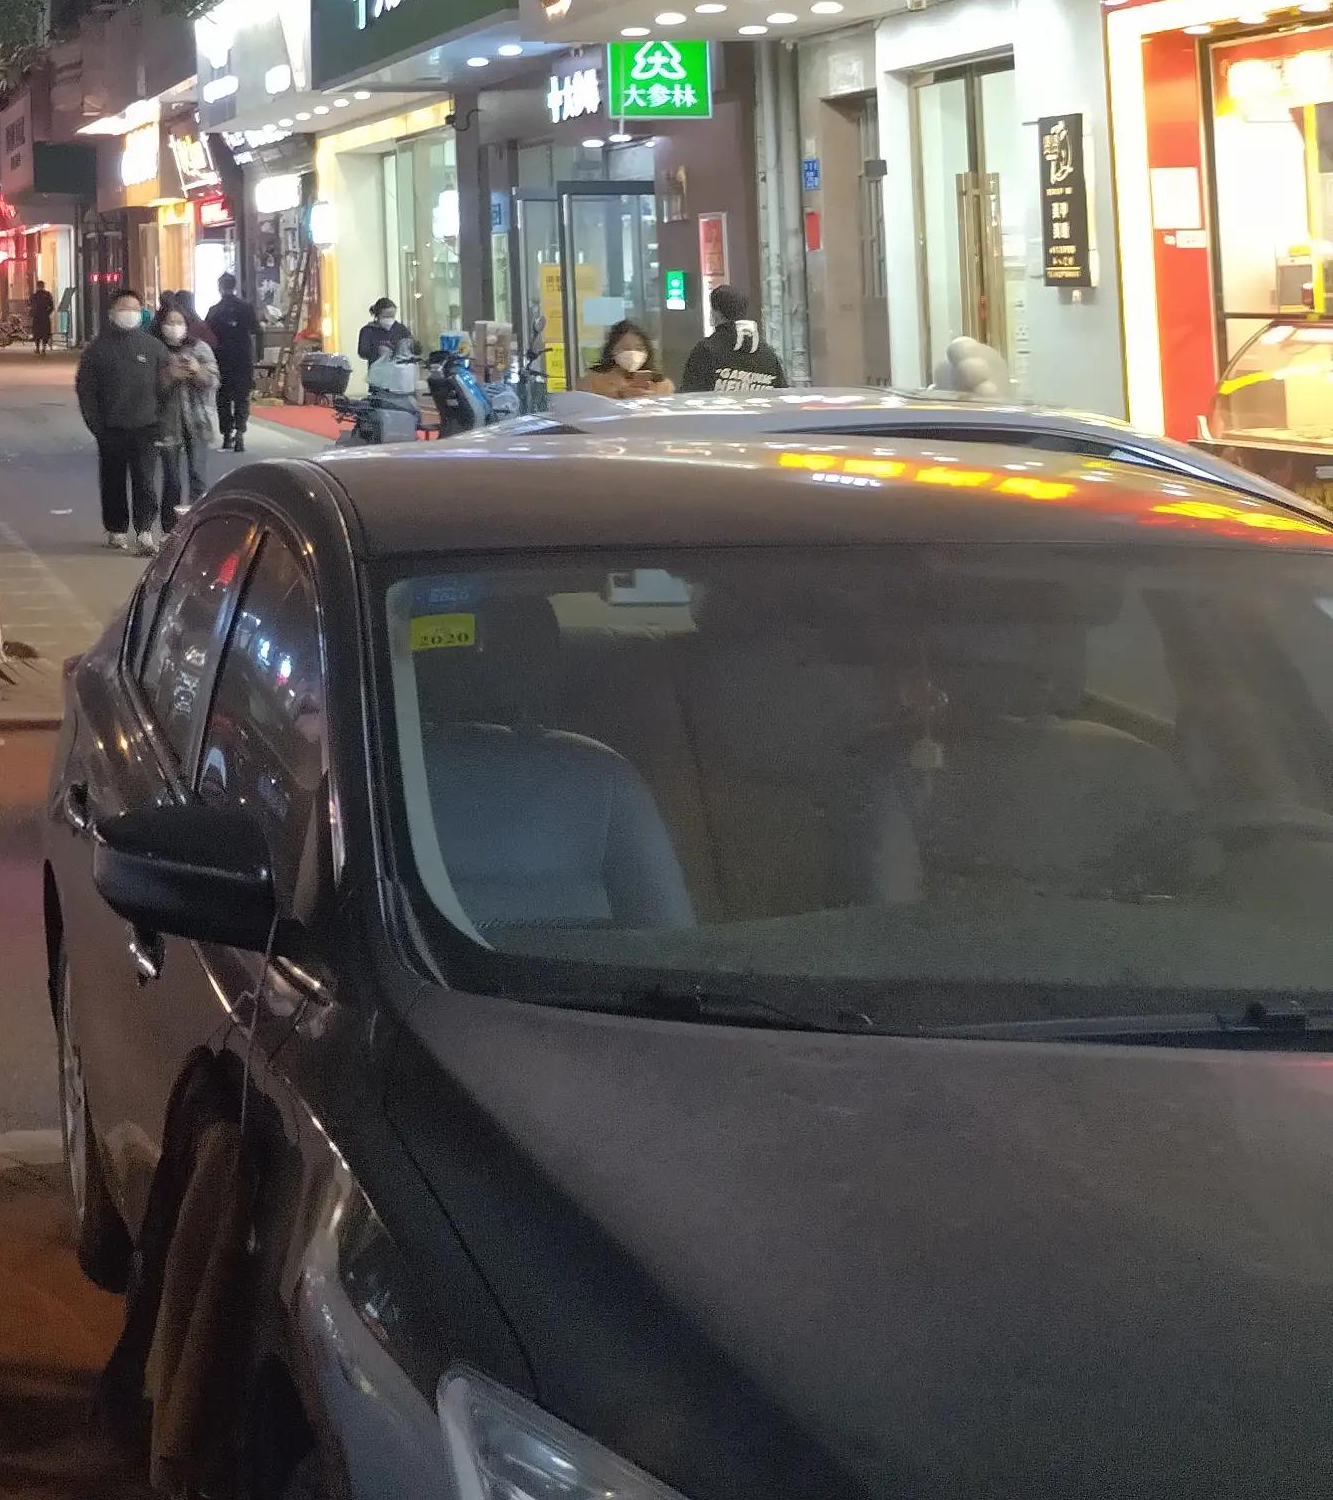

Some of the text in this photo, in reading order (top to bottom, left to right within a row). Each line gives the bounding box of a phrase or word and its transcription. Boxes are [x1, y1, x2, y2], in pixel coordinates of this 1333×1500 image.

[623, 84, 697, 108] 大参林
[420, 632, 469, 647] 2020
